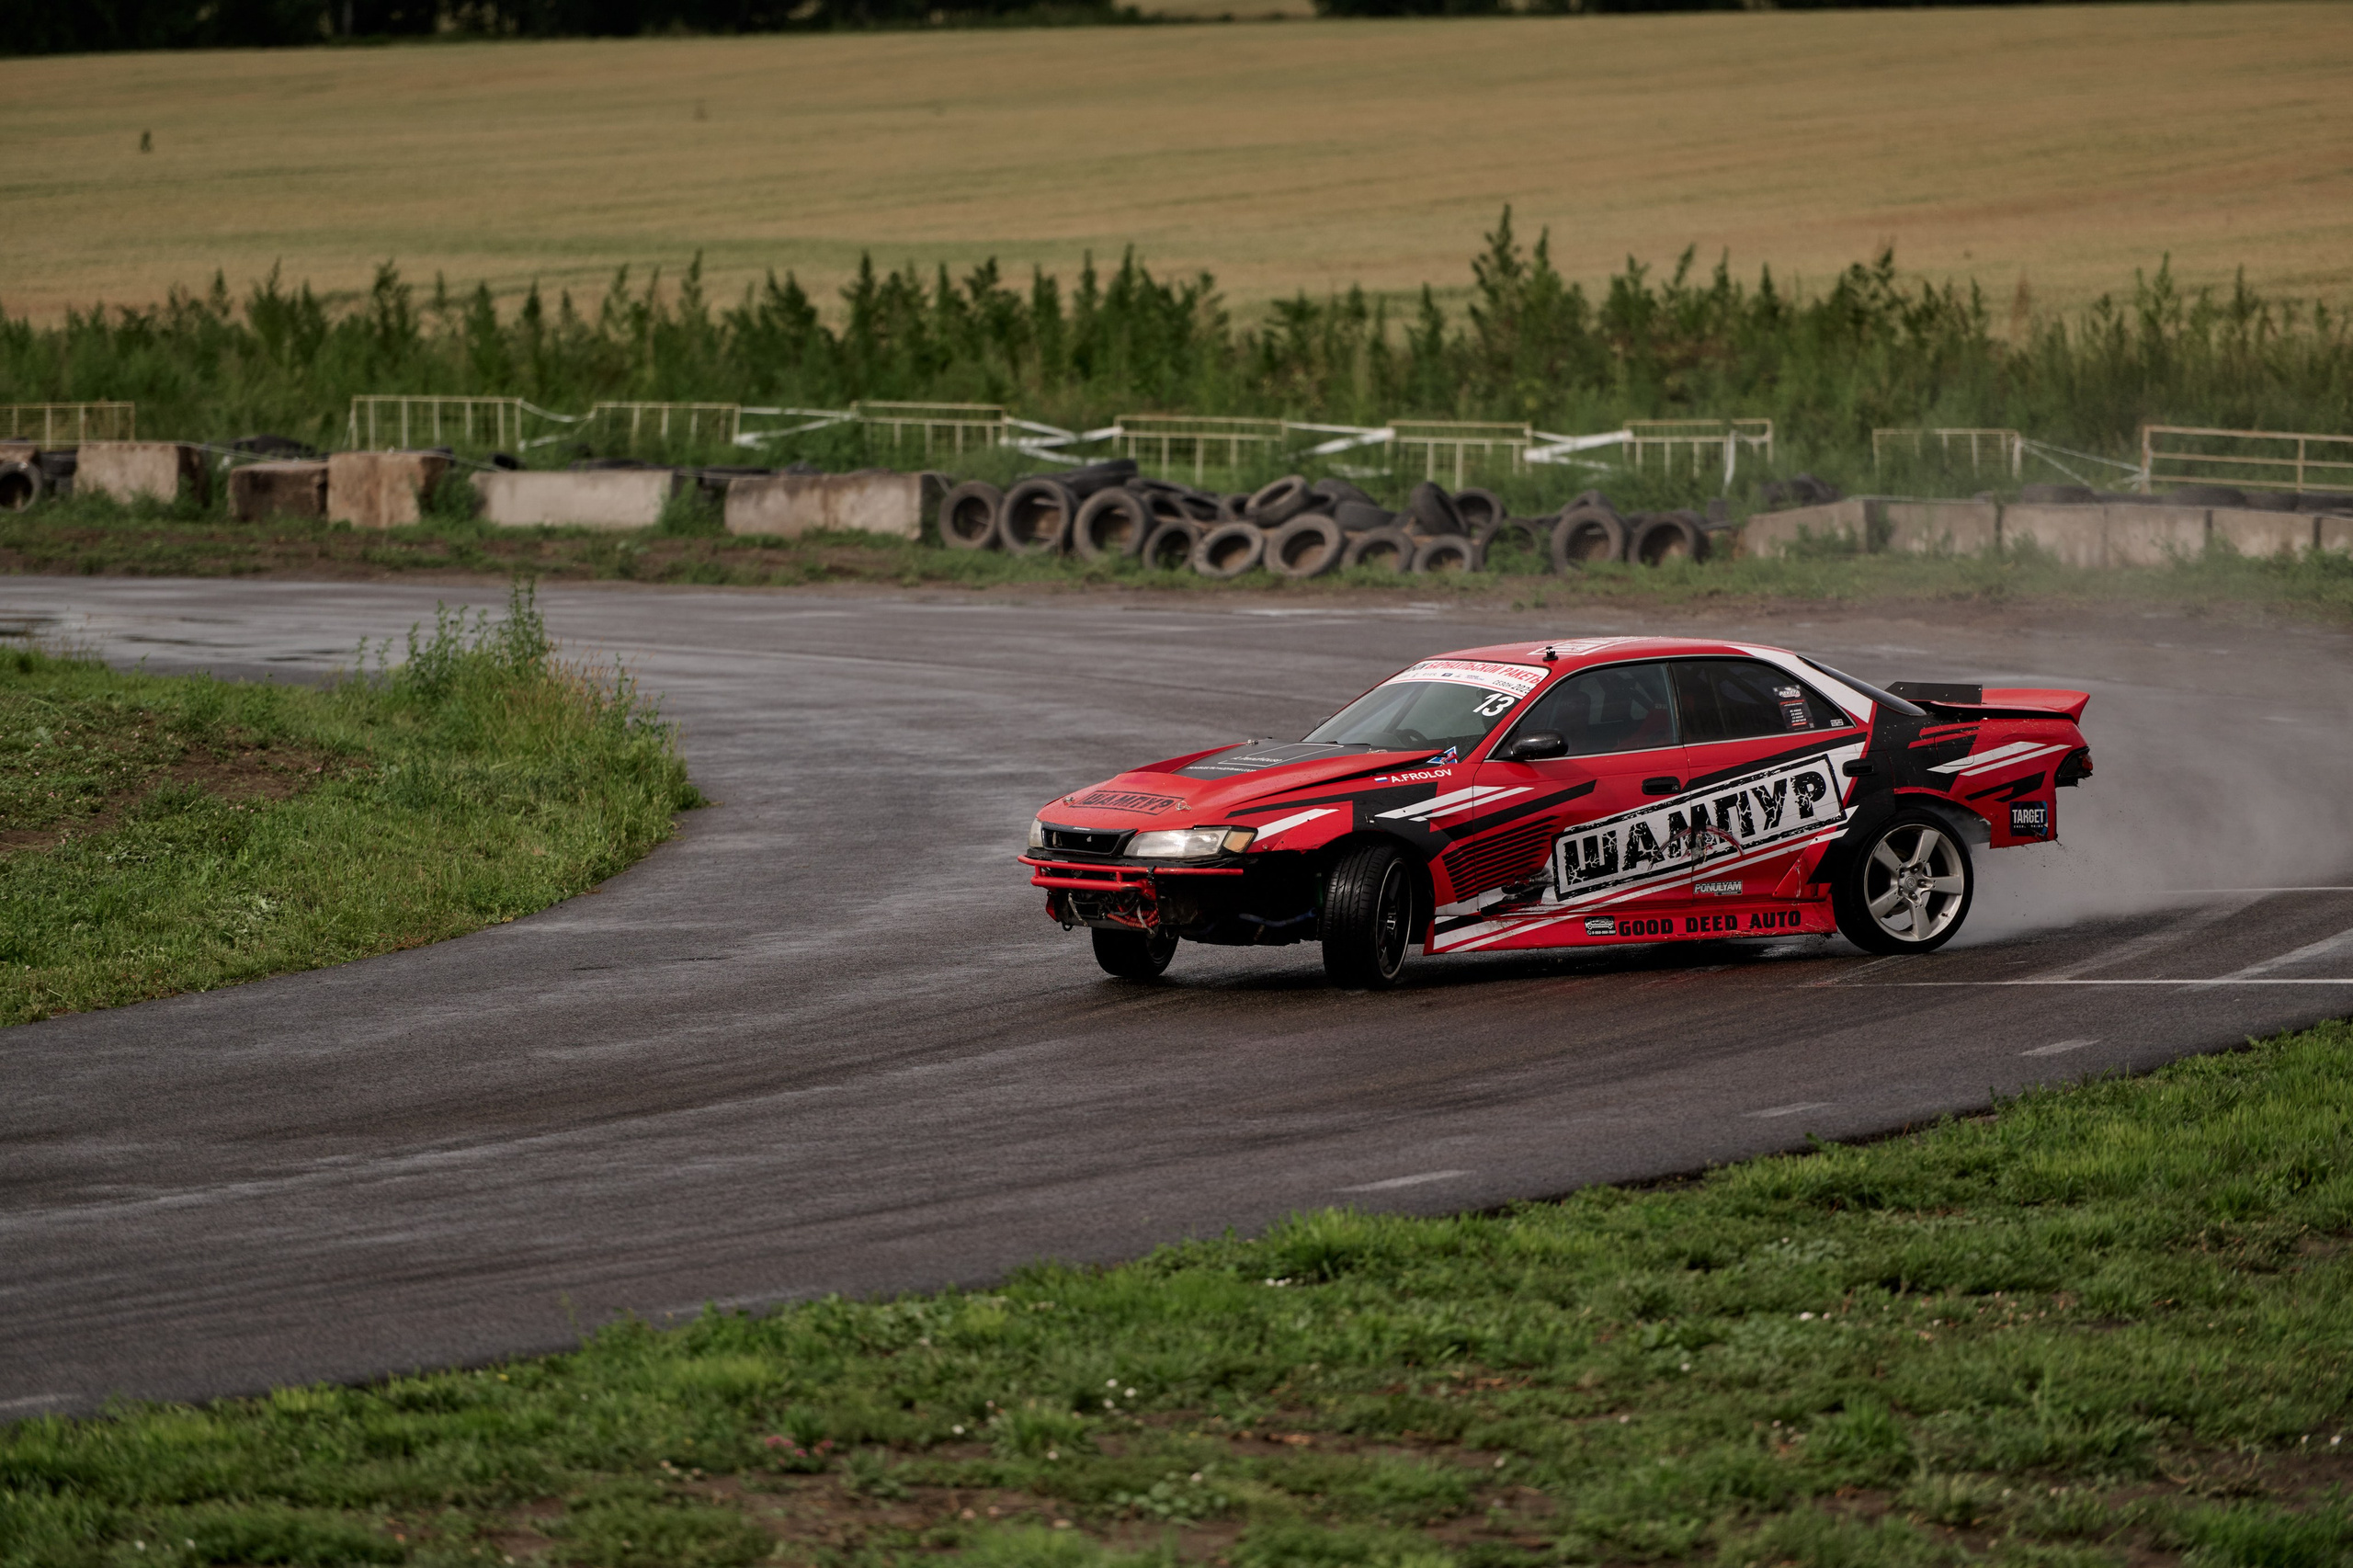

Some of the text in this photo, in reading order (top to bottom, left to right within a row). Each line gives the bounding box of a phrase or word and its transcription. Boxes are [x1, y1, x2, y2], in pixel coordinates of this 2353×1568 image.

[1472, 692, 1515, 716] 13
[1078, 793, 1175, 811] ШАМПУР
[2012, 809, 2045, 824] TARGET
[1563, 770, 1827, 886] ШАМПУР
